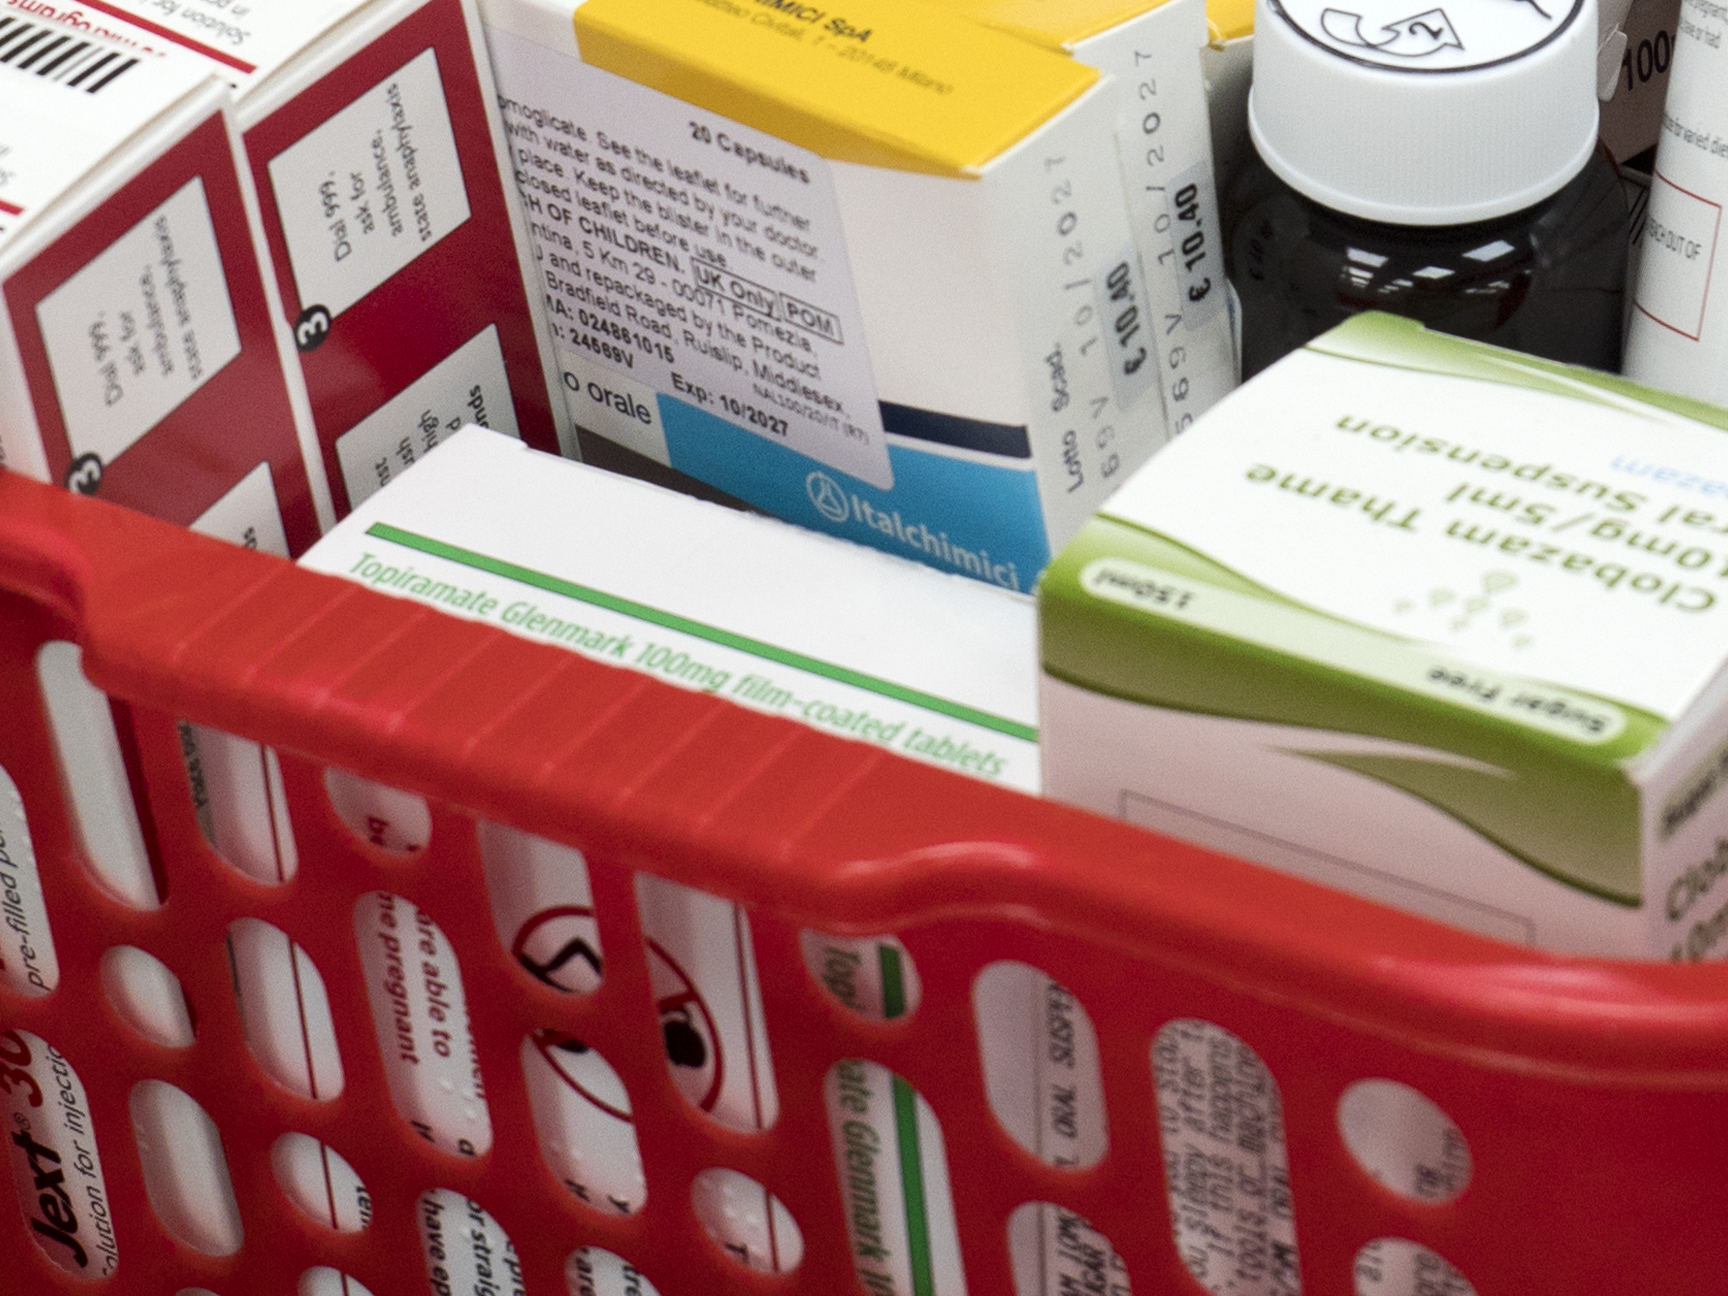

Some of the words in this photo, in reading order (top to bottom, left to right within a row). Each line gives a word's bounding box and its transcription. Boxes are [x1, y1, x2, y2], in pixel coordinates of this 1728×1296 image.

[385, 80, 422, 191] anaphylaxis
[317, 169, 342, 219] 999,
[348, 170, 367, 202] for
[353, 199, 376, 236] ask
[369, 127, 405, 238] ambulance,
[410, 191, 434, 243] state
[326, 216, 354, 263] Dial
[1175, 182, 1207, 273] 10.40
[1188, 276, 1212, 303] €
[669, 369, 715, 406] Exp:
[717, 393, 790, 438] 10/2027
[1243, 462, 1422, 533] Thame
[1333, 413, 1647, 525] Suspension
[851, 494, 1020, 592] Italchimici
[1443, 518, 1718, 614] Clobazam
[344, 544, 502, 623] Topiramate
[496, 593, 635, 664] Glenmark
[632, 635, 733, 695] 100mg
[728, 665, 905, 748] film-coated
[898, 718, 1010, 781] tablets
[377, 938, 421, 1066] pregnant
